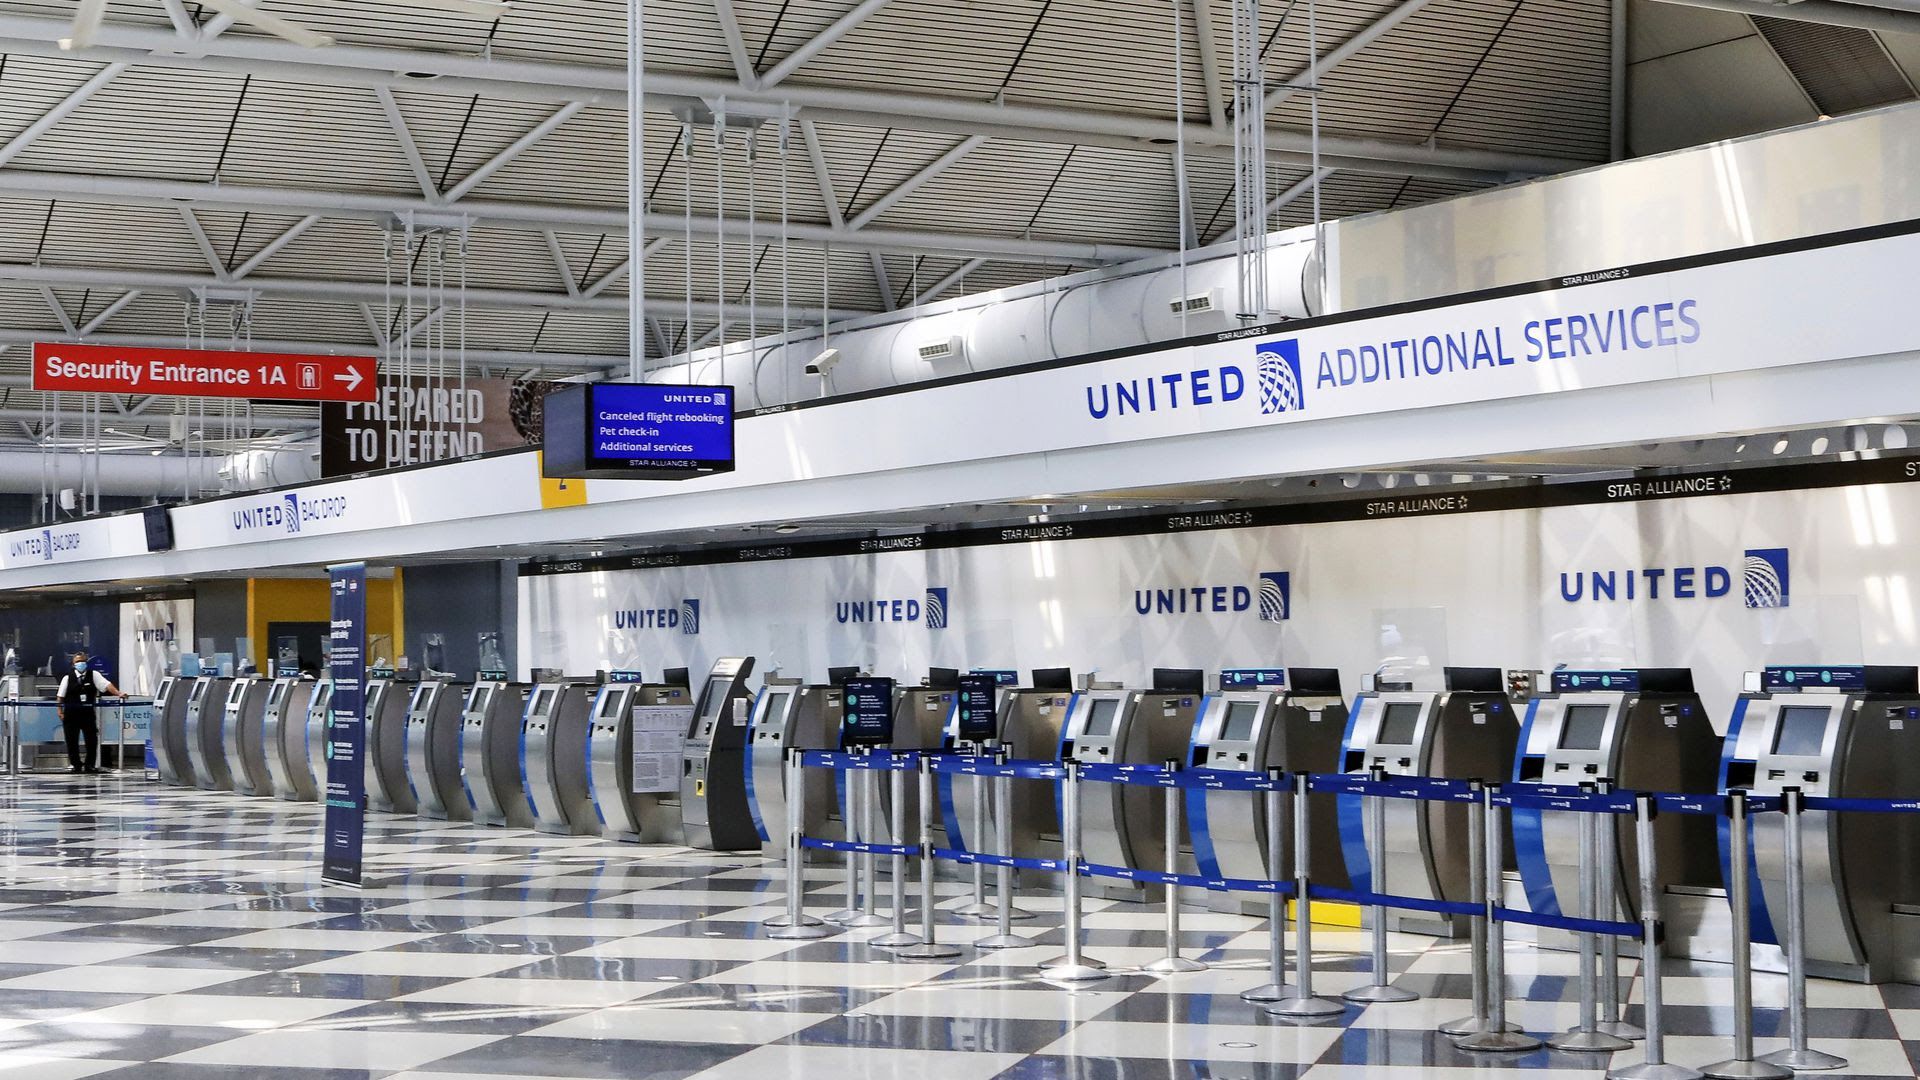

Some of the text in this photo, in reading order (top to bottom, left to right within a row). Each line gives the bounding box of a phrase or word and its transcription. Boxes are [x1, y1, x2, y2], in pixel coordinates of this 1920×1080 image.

[1562, 270, 1621, 287] STAR ALLIANCE
[1087, 299, 1701, 420] UNITED ADDITIONAL SERVICES
[46, 356, 287, 385] Security Entrance 1A
[664, 394, 712, 403] UNITED
[600, 411, 725, 425] Canceled flight rebooking
[600, 427, 659, 436] Pet check-in
[345, 428, 485, 464] TO DEFEND
[600, 442, 694, 452] Additional services
[1607, 476, 1716, 498] STAR ALLIANCE
[233, 505, 282, 530] UNITED
[322, 496, 346, 519] DROP
[1366, 497, 1455, 515] STAR ALLIANCE
[1168, 513, 1242, 528] STAR ALLIANCE
[1001, 526, 1064, 540] STAR ALLIANCE
[11, 538, 41, 557] UNITED
[878, 537, 914, 549] ALLIANCE
[1560, 566, 1732, 602] UNITED
[1135, 585, 1251, 615] UNITED
[615, 608, 679, 629] UNITED
[836, 599, 920, 623] UNITED
[114, 711, 141, 719] Yu're
